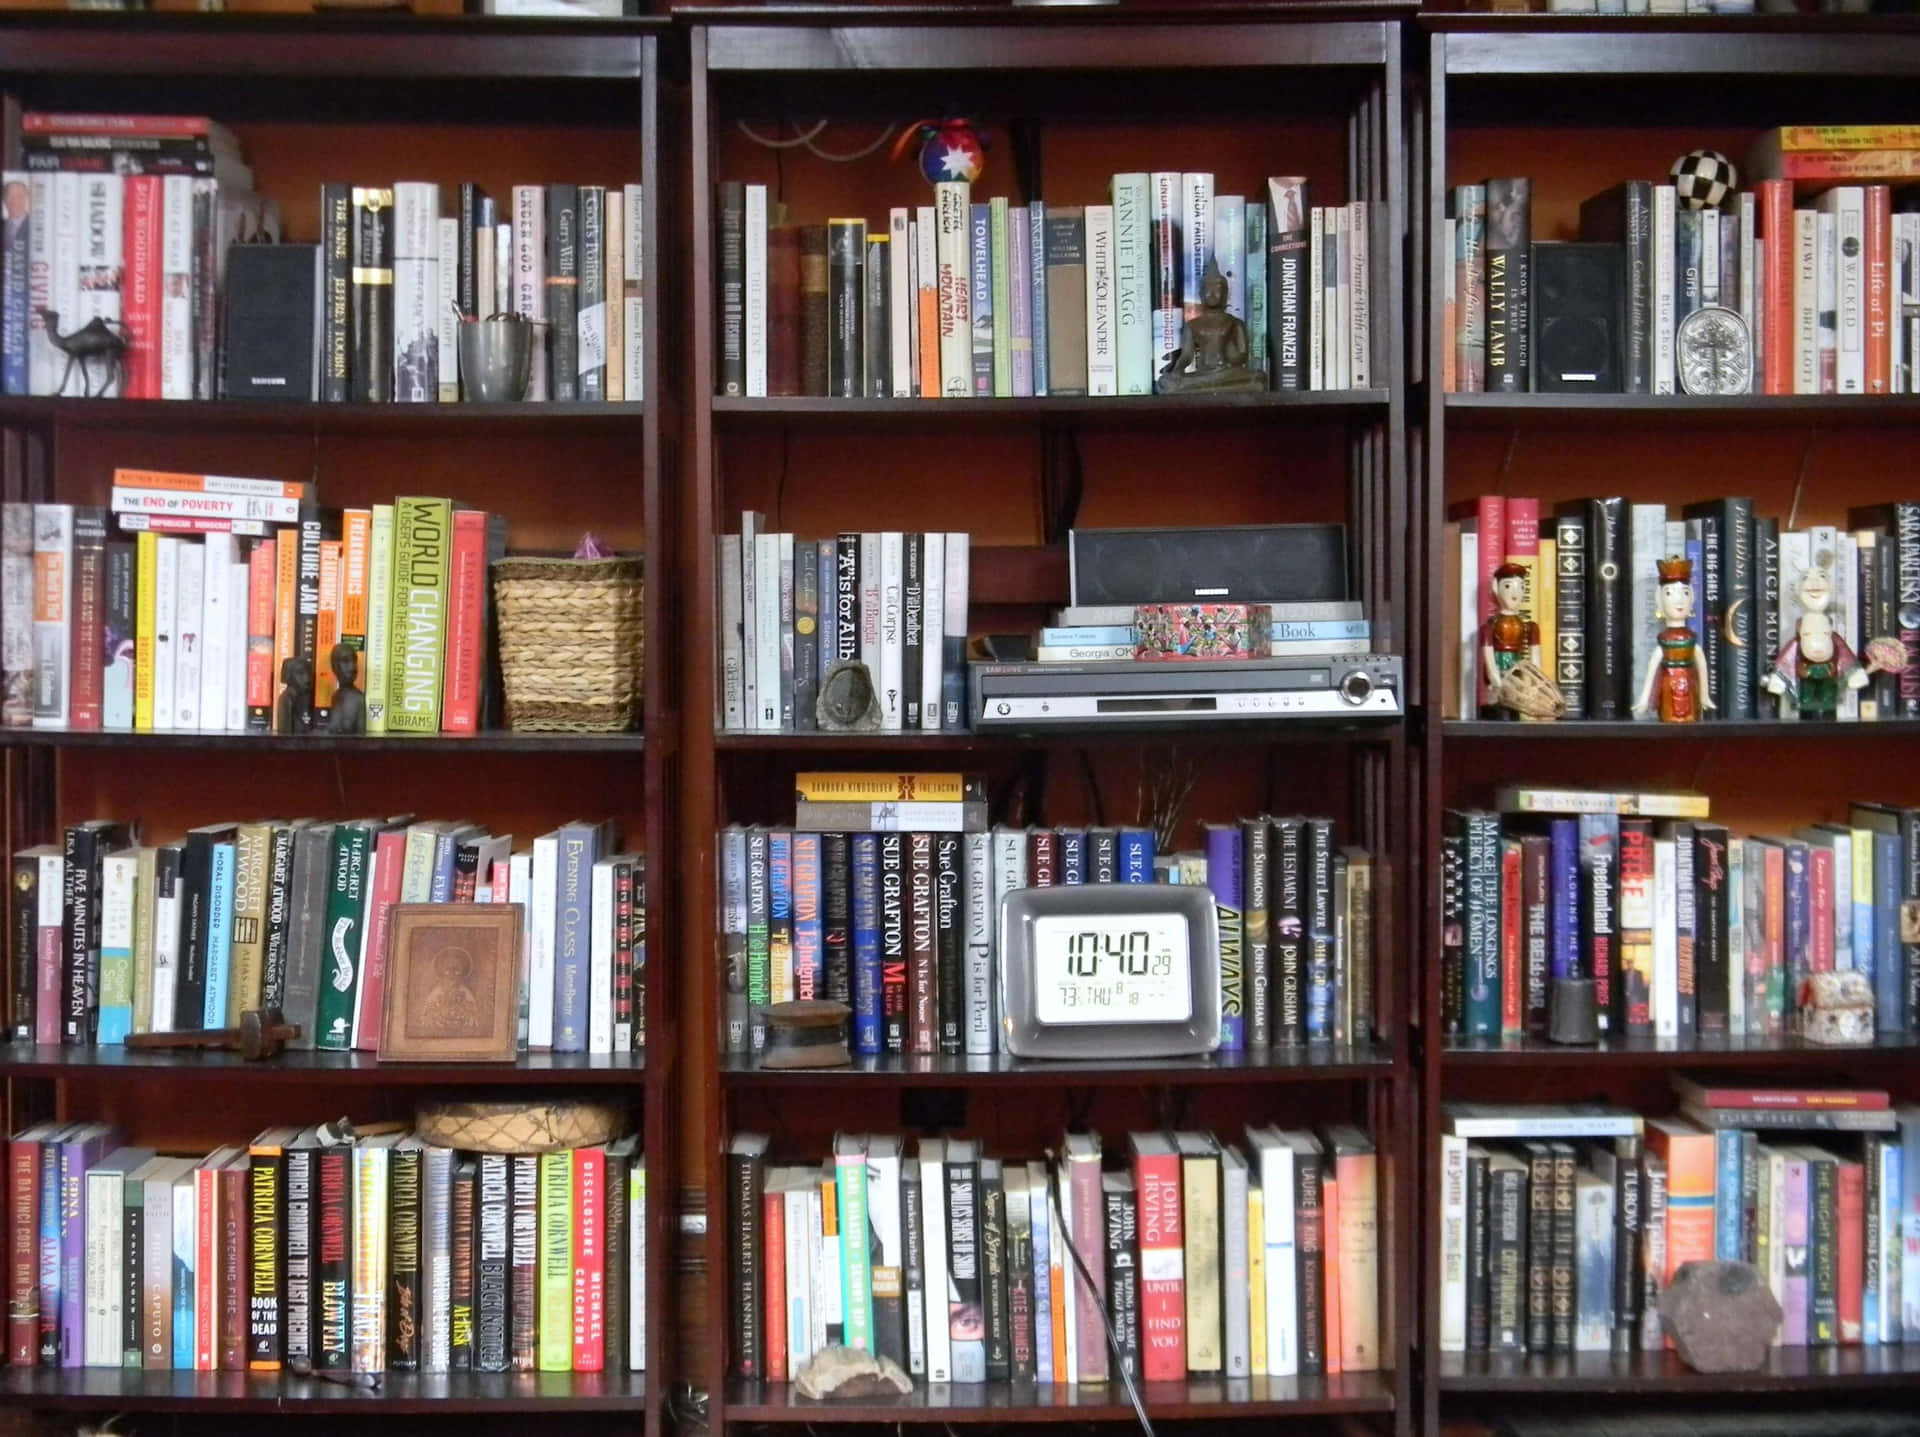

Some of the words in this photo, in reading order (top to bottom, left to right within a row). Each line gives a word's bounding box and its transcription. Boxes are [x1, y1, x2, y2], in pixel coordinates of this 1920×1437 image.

[335, 198, 346, 223] THE
[557, 209, 573, 244] Garry
[585, 198, 599, 238] God's
[1120, 186, 1134, 256] FANNIE
[335, 227, 346, 259] NINE
[560, 246, 573, 275] Wills
[976, 218, 986, 300] TOWELHEAD
[1096, 231, 1107, 270] WHITE
[585, 242, 599, 293] Politics
[1282, 258, 1296, 313] JONATHAN
[1491, 254, 1505, 312] WALLY
[1686, 267, 1697, 297] Girls
[1871, 262, 1884, 293] Life
[335, 278, 345, 325] JEFFREY
[940, 264, 953, 338] MOUNTAIN
[956, 277, 967, 322] HEART
[1121, 265, 1135, 326] FLAGG
[1845, 262, 1856, 328] WICKED
[1871, 299, 1883, 314] of
[1096, 284, 1108, 355] OLEANDER
[1872, 321, 1884, 337] Pi
[335, 331, 345, 378] TOOBIN
[1283, 316, 1296, 366] FRANZEN
[1491, 320, 1505, 366] LAMB
[124, 496, 139, 506] THE
[142, 497, 166, 508] END
[168, 500, 177, 508] OF
[181, 499, 234, 513] POVERTY
[1488, 504, 1497, 529] IAN
[1902, 504, 1920, 544] SARA
[301, 521, 321, 579] CULTURE
[398, 511, 410, 550] USER'S
[348, 517, 366, 595] FREAKONOMICS
[397, 552, 409, 583] GUIDE
[1766, 538, 1777, 601] ALICE
[300, 584, 318, 614] JAM
[396, 587, 408, 608] FOR
[395, 611, 406, 630] THE
[883, 604, 898, 645] Corpse
[1280, 624, 1316, 638] Book
[394, 633, 406, 658] 21ST
[1070, 649, 1110, 660] Georgia
[392, 662, 404, 708] CENTURY
[392, 715, 433, 728] ABRAMS
[796, 839, 816, 861] SUE
[883, 836, 899, 870] SUE
[912, 838, 929, 870] SUE
[939, 840, 956, 869] Sue
[972, 839, 983, 866] SUE
[1065, 839, 1078, 866] SUE
[1099, 839, 1111, 865] SUE
[1130, 843, 1142, 869] SUE
[1284, 829, 1297, 850] THE
[1469, 821, 1484, 872] PIERCY
[1483, 821, 1498, 872] MARGE
[74, 869, 87, 893] FIVE
[216, 852, 224, 881] MORAL
[235, 833, 249, 912] ATWOOD
[248, 834, 263, 912] MARGARET
[336, 843, 348, 892] ATWOOD
[348, 837, 363, 900] MARGARET
[1284, 853, 1297, 910] TESTAMENT
[1677, 835, 1693, 890] JONATHAN
[796, 864, 816, 921] GRAFTON
[939, 871, 958, 929] Grafton
[971, 871, 985, 937] GRAFTON
[1445, 850, 1455, 918] PERRY
[1470, 877, 1482, 897] OF
[1485, 877, 1498, 906] THE
[74, 898, 85, 950] MINUTES
[213, 885, 223, 928] DISORDER
[884, 874, 901, 956] GRAFTON
[912, 873, 930, 952] GRAFTON
[1529, 904, 1545, 936] THE
[1678, 894, 1693, 929] RABAN
[73, 954, 85, 966] IN
[919, 959, 928, 969] N
[969, 942, 989, 959] P
[1068, 931, 1150, 977] 10:40
[1253, 943, 1267, 973] JOHN
[1281, 944, 1297, 973] JOHN
[1485, 909, 1497, 979] LONGINGS
[1530, 938, 1545, 971] BELL
[883, 962, 905, 984] M
[973, 962, 984, 973] is
[1152, 955, 1172, 976] 29
[1678, 936, 1694, 995] WAXWINGS
[72, 970, 83, 1016] HEAVEN
[918, 980, 928, 993] for
[973, 977, 986, 997] for
[1255, 976, 1267, 1026] GRISHAM
[1284, 976, 1297, 1025] GRISHAM
[918, 995, 928, 1023] Noose
[974, 1001, 988, 1033] Peril
[254, 1166, 274, 1223] PATRICIA
[288, 1152, 308, 1200] PATRICIA
[321, 1155, 344, 1204] PATRICIA
[394, 1154, 417, 1207] PATRICIA
[482, 1155, 506, 1200] PATRICIA
[514, 1157, 536, 1206] PATRICIA
[547, 1153, 568, 1208] PATRICIA
[742, 1163, 752, 1217] THOMAS
[69, 1176, 79, 1218] EDNA
[584, 1162, 592, 1256] DISCLOSURE
[907, 1190, 917, 1229] Hawkes
[1144, 1173, 1160, 1243] IRVING
[1160, 1181, 1178, 1233] JOHN
[1624, 1168, 1637, 1232] TUROW
[287, 1202, 309, 1256] CORNWELL
[321, 1207, 343, 1263] CORNWELL
[481, 1204, 506, 1260] CORNWELL
[513, 1210, 536, 1266] CORNWELL
[951, 1219, 974, 1242] SENSE
[1108, 1195, 1122, 1250] IRVING
[1123, 1202, 1134, 1240] JOHN
[253, 1227, 275, 1294] CORNWELL
[393, 1211, 416, 1275] CORNWELL
[547, 1212, 569, 1279] CORNWELL
[742, 1221, 752, 1274] HARRIS
[908, 1231, 918, 1266] Harbor
[953, 1243, 975, 1253] OF
[288, 1259, 308, 1278] THE
[953, 1255, 976, 1280] SNOW
[288, 1280, 308, 1305] LAST
[322, 1280, 345, 1325] BLOW
[576, 1268, 584, 1344] CRICHTON
[591, 1271, 600, 1341] MICHAEL
[1114, 1281, 1125, 1310] PIGGY
[1124, 1272, 1134, 1308] TRYING
[1146, 1282, 1181, 1295] UNTIL
[252, 1323, 277, 1335] DEAD
[287, 1305, 309, 1356] PRECINCT
[742, 1282, 752, 1354] HANNIBAL
[1115, 1313, 1125, 1342] SNEED
[1126, 1312, 1134, 1324] TO
[1148, 1319, 1181, 1329] FIND
[322, 1325, 345, 1352] FLY
[1126, 1327, 1136, 1350] SAVE
[1152, 1337, 1179, 1348] YOU
